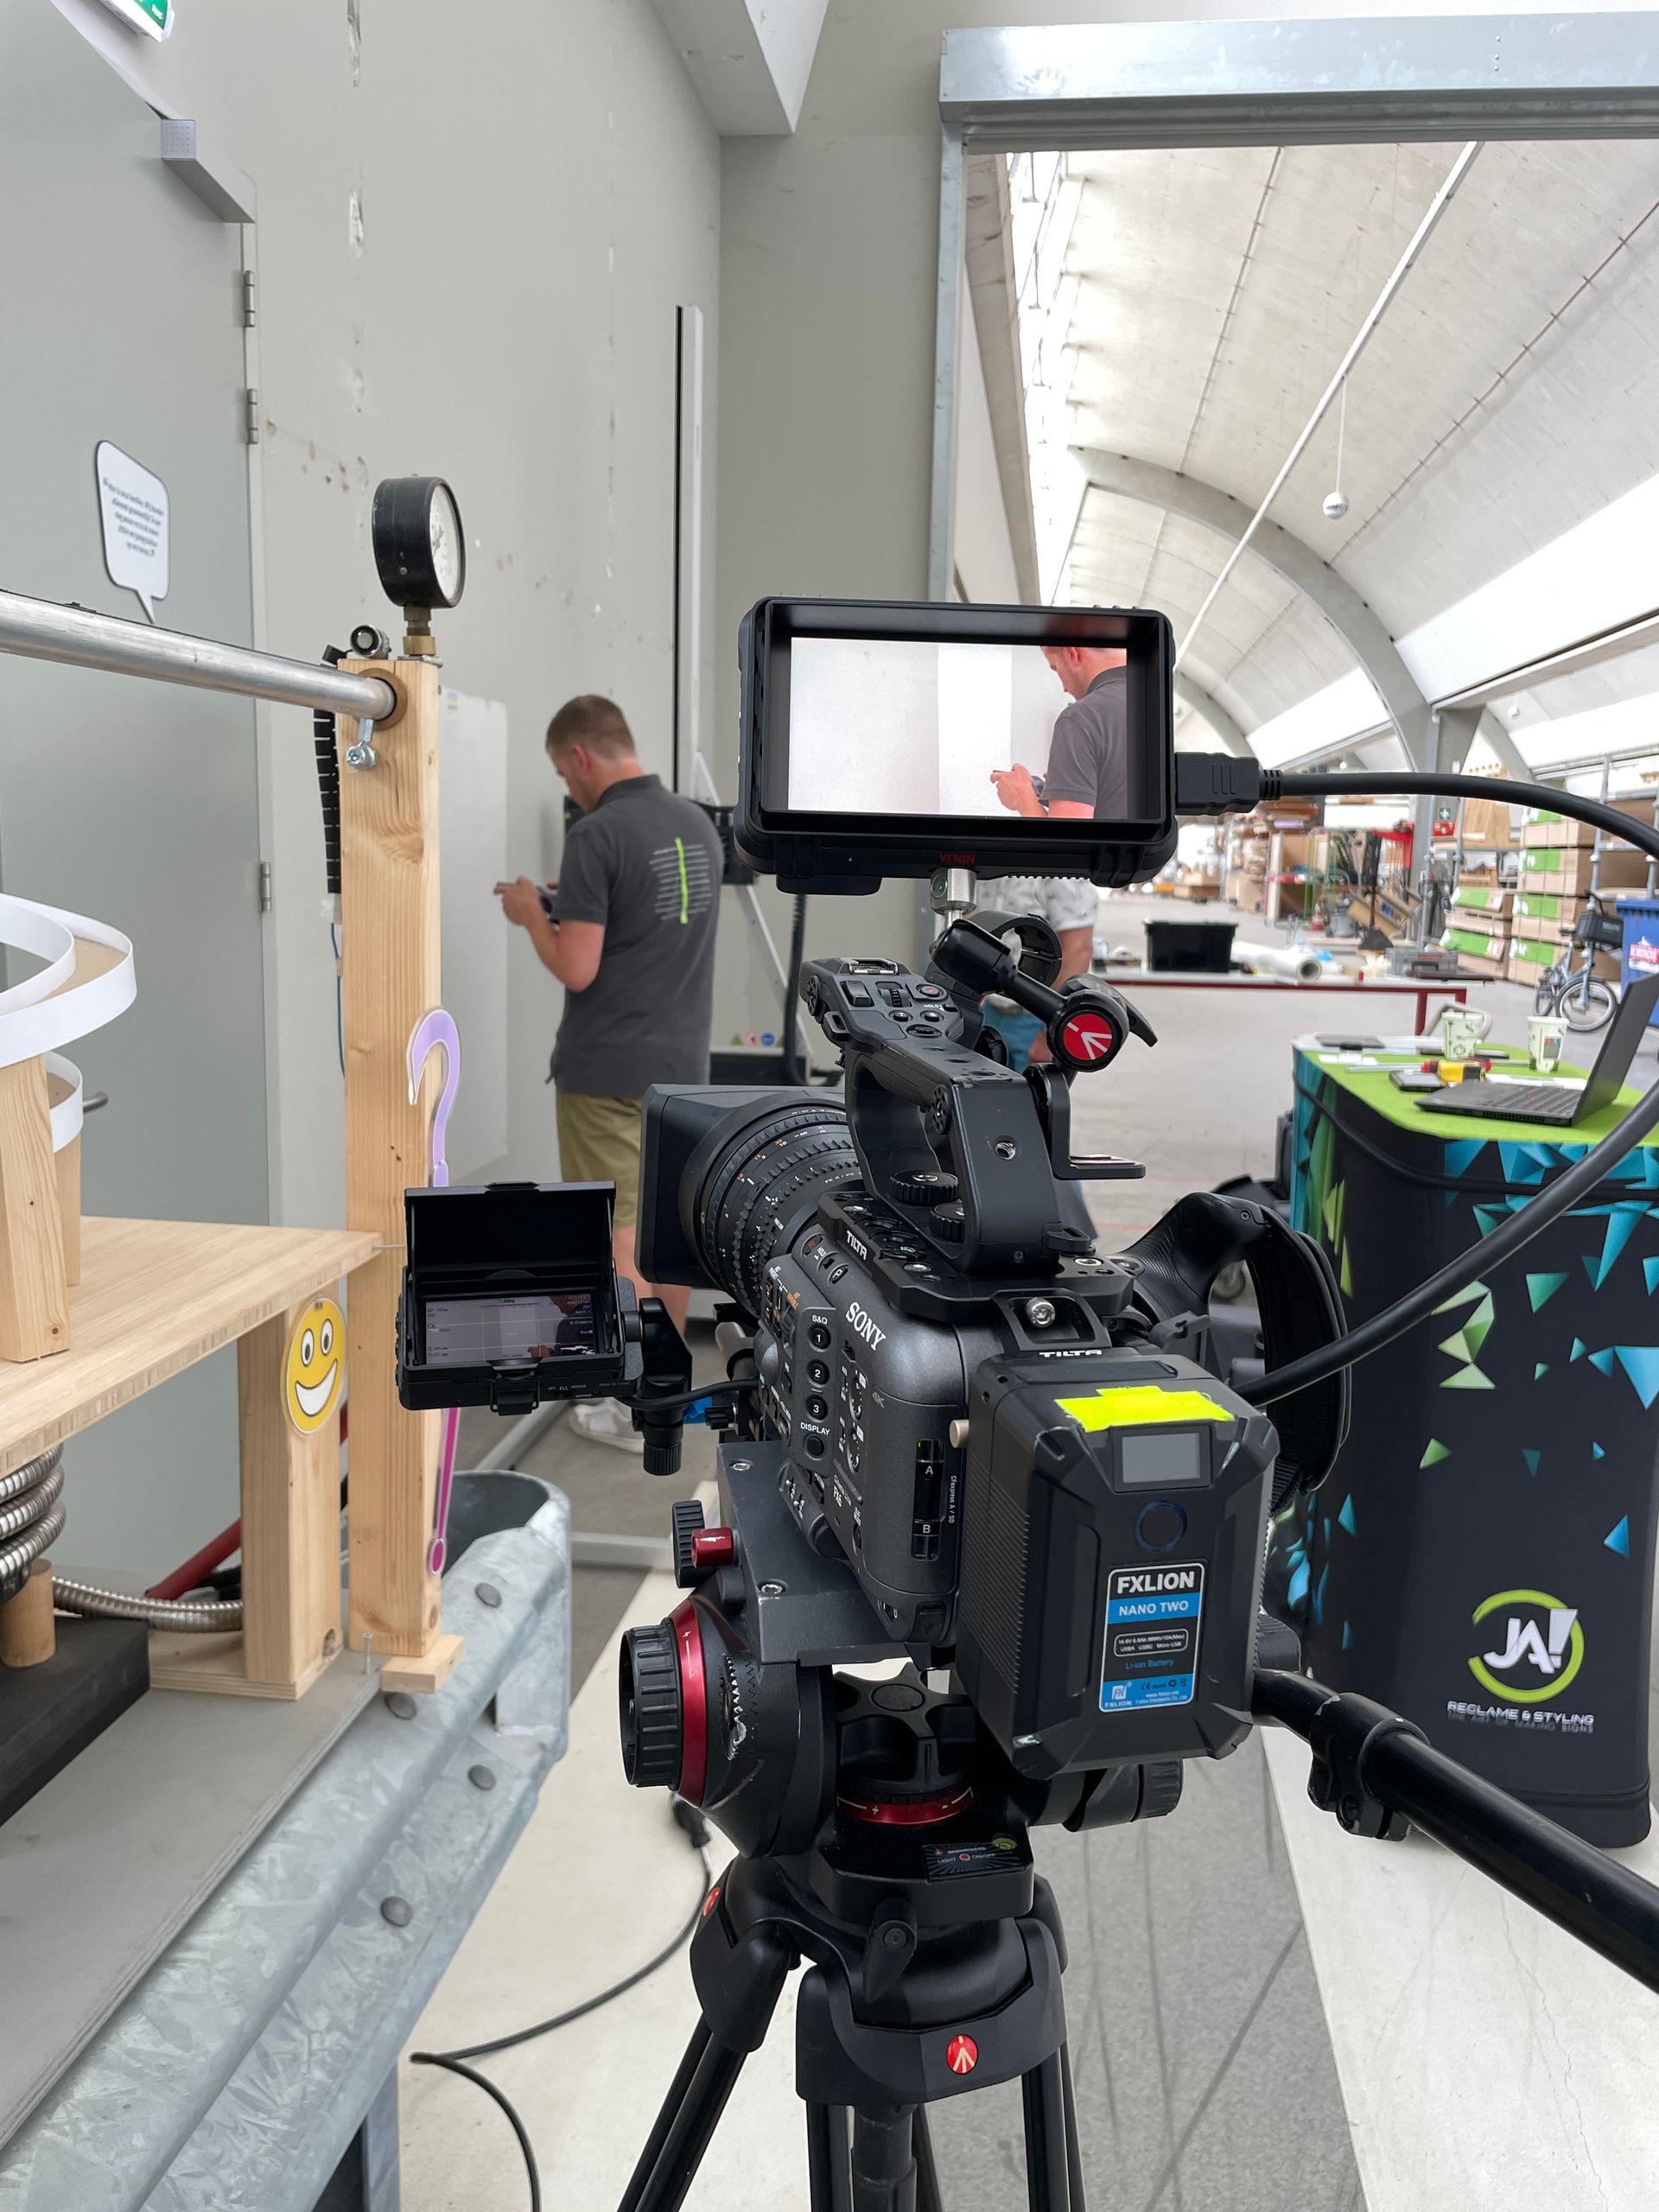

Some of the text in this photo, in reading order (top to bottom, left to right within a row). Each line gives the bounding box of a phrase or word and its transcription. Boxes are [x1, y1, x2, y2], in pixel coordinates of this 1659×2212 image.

[846, 1230, 868, 1261] TILTA
[811, 1314, 828, 1325] S&Q
[846, 1301, 887, 1351] SONY
[817, 1333, 821, 1344] 1
[1039, 1349, 1103, 1358] TILTA
[814, 1369, 821, 1378] 2
[872, 1391, 886, 1409] 4K
[813, 1404, 820, 1414] 3
[800, 1421, 830, 1436] DISPLAY
[925, 1465, 934, 1476] A
[922, 1523, 931, 1534] B
[1117, 1571, 1195, 1594] FXLION
[1119, 1600, 1189, 1617] NANO TWO
[1483, 1609, 1578, 1675] JA!
[1147, 1658, 1175, 1668] Battery
[1521, 1710, 1531, 1721] &
[1533, 1711, 1595, 1725] STYLING
